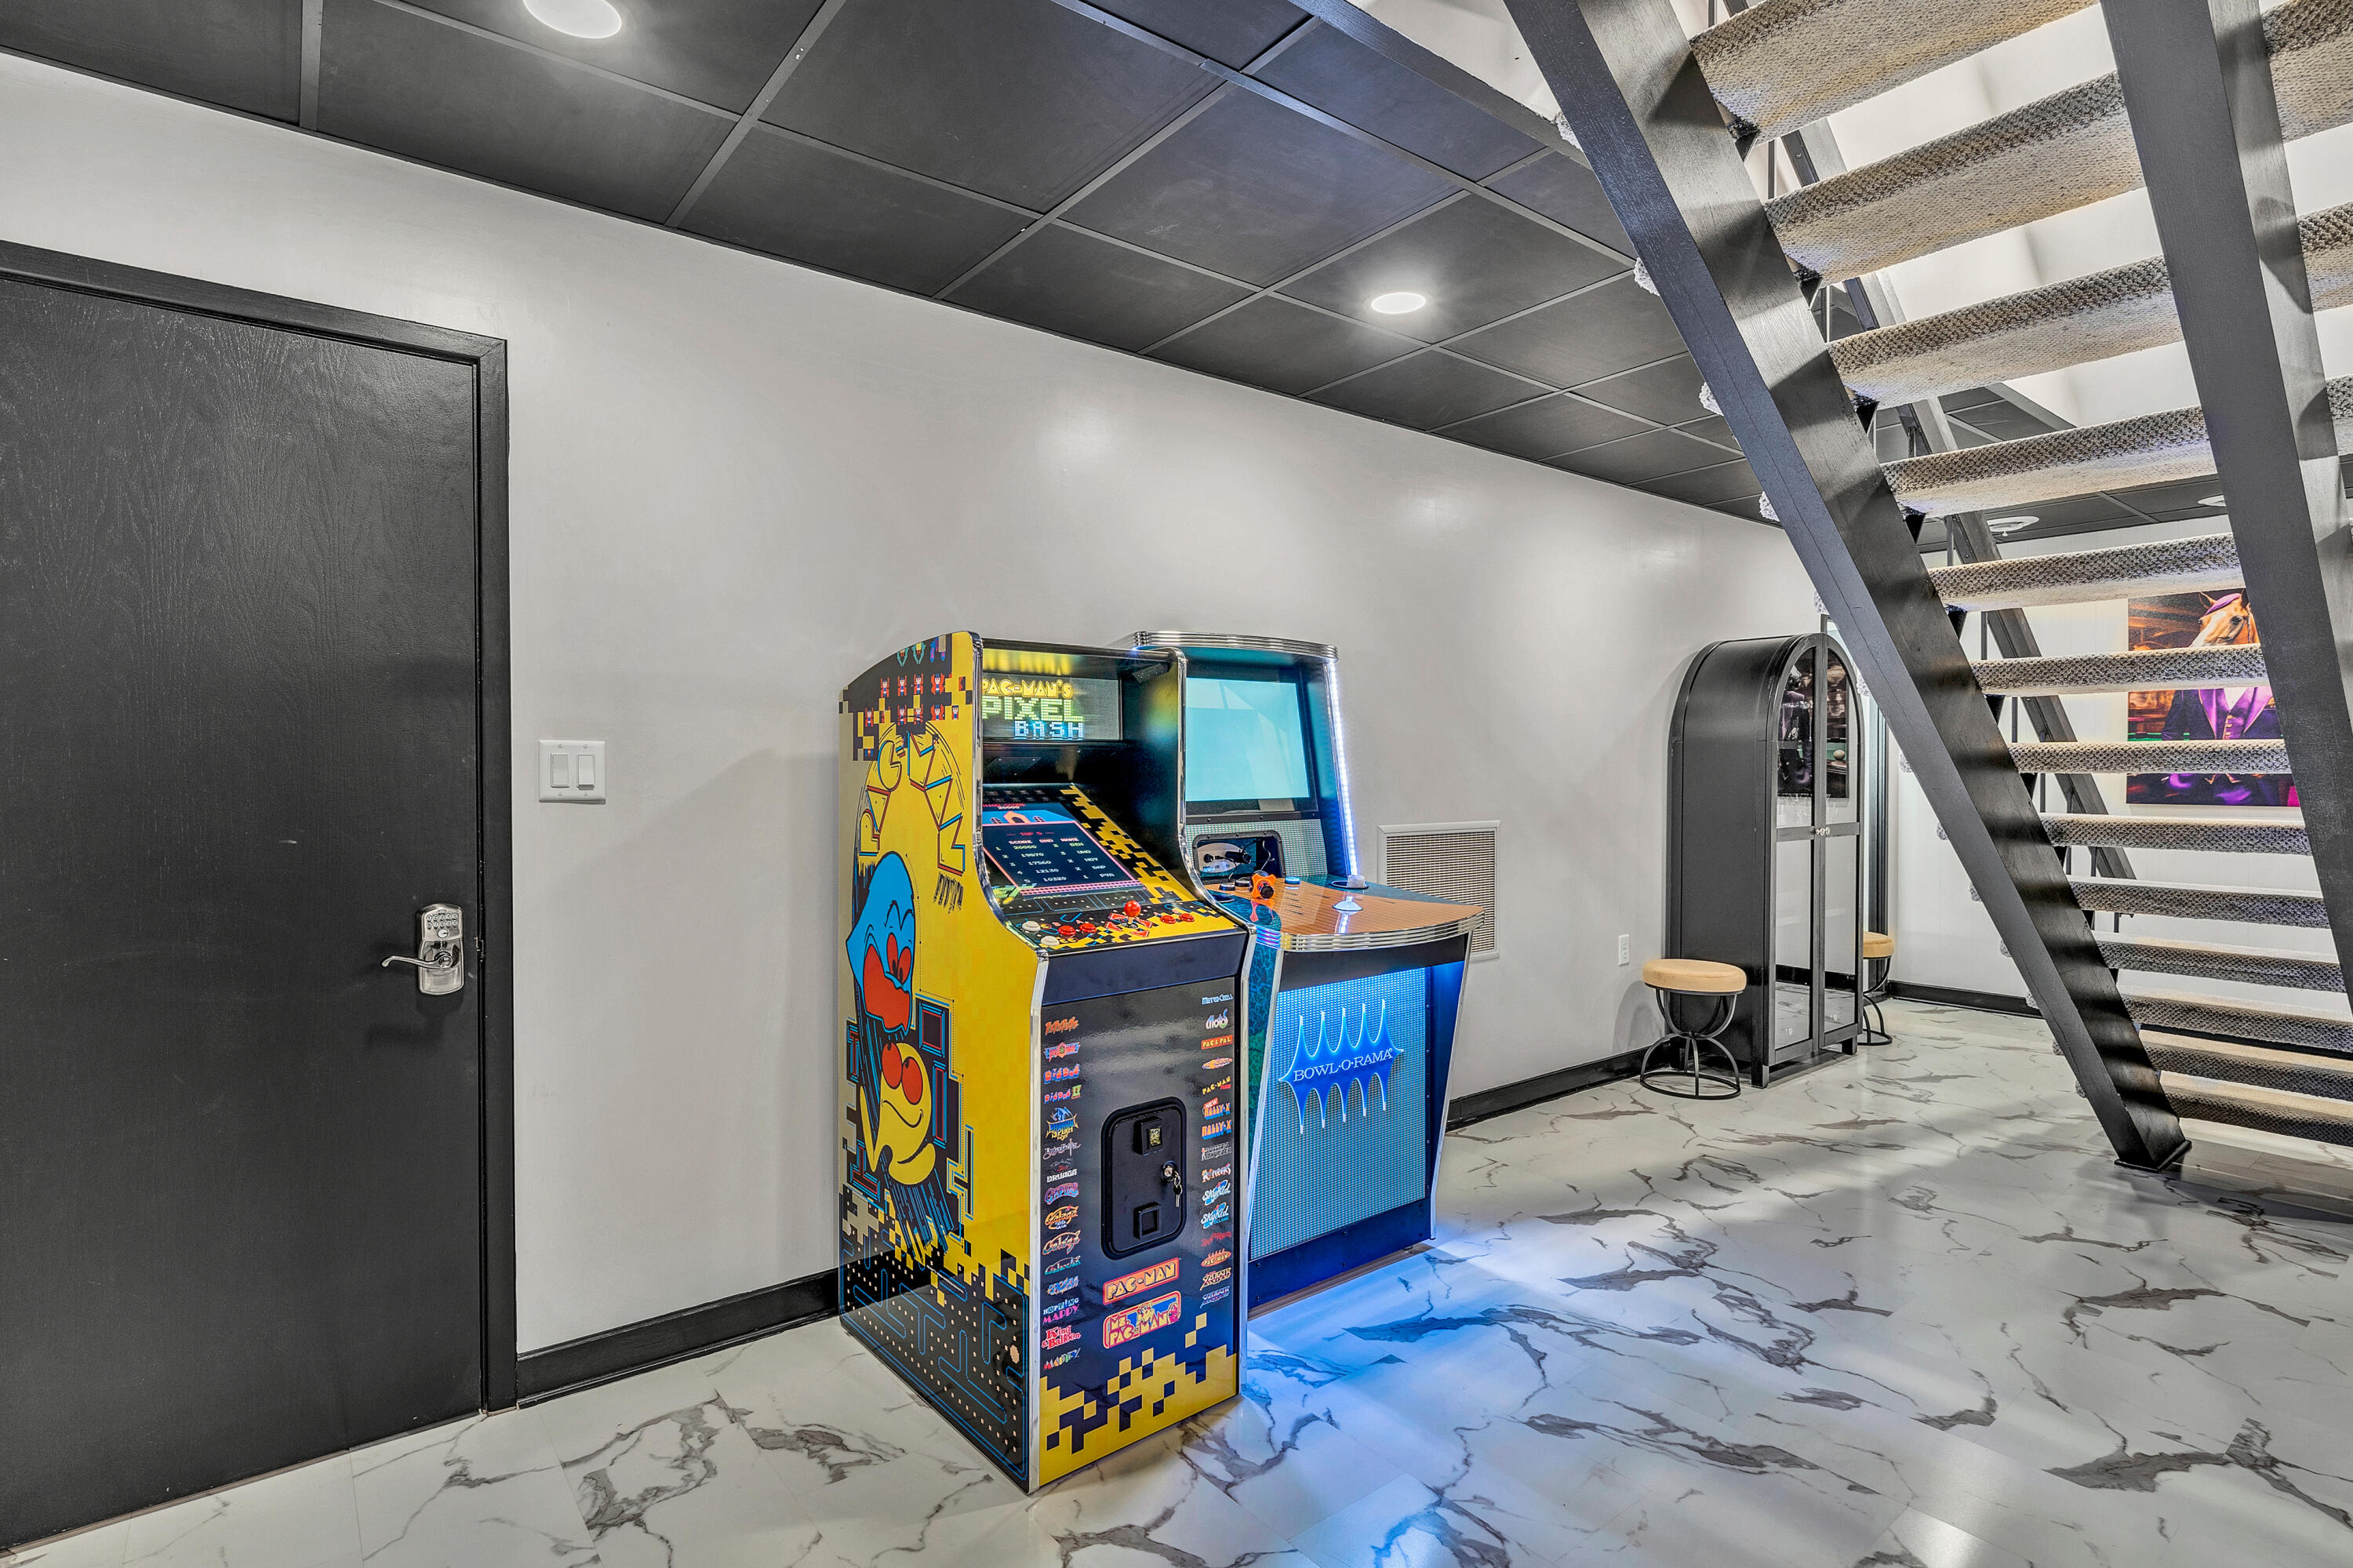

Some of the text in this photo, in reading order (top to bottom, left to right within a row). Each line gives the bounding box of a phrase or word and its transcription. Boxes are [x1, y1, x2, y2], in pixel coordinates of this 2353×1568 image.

[982, 678, 1073, 699] PAC-MAN'S
[982, 696, 1083, 722] PIXEL
[1014, 721, 1084, 737] BASH
[1202, 1039, 1214, 1049] PAC
[1220, 1035, 1231, 1045] PAL
[1202, 1075, 1231, 1095] PAC-MAN
[1204, 1103, 1231, 1120] RALLY-X
[1205, 1098, 1218, 1109] NEW
[1202, 1119, 1231, 1140] RALLY-X
[1047, 1169, 1078, 1183] DRUAGA
[1107, 1262, 1176, 1300] PAC-MAN
[1042, 1304, 1079, 1325] MAPPY
[1046, 1325, 1071, 1340] King
[1110, 1311, 1169, 1348] PAC-MAN
[1047, 1332, 1081, 1349] Balloon
